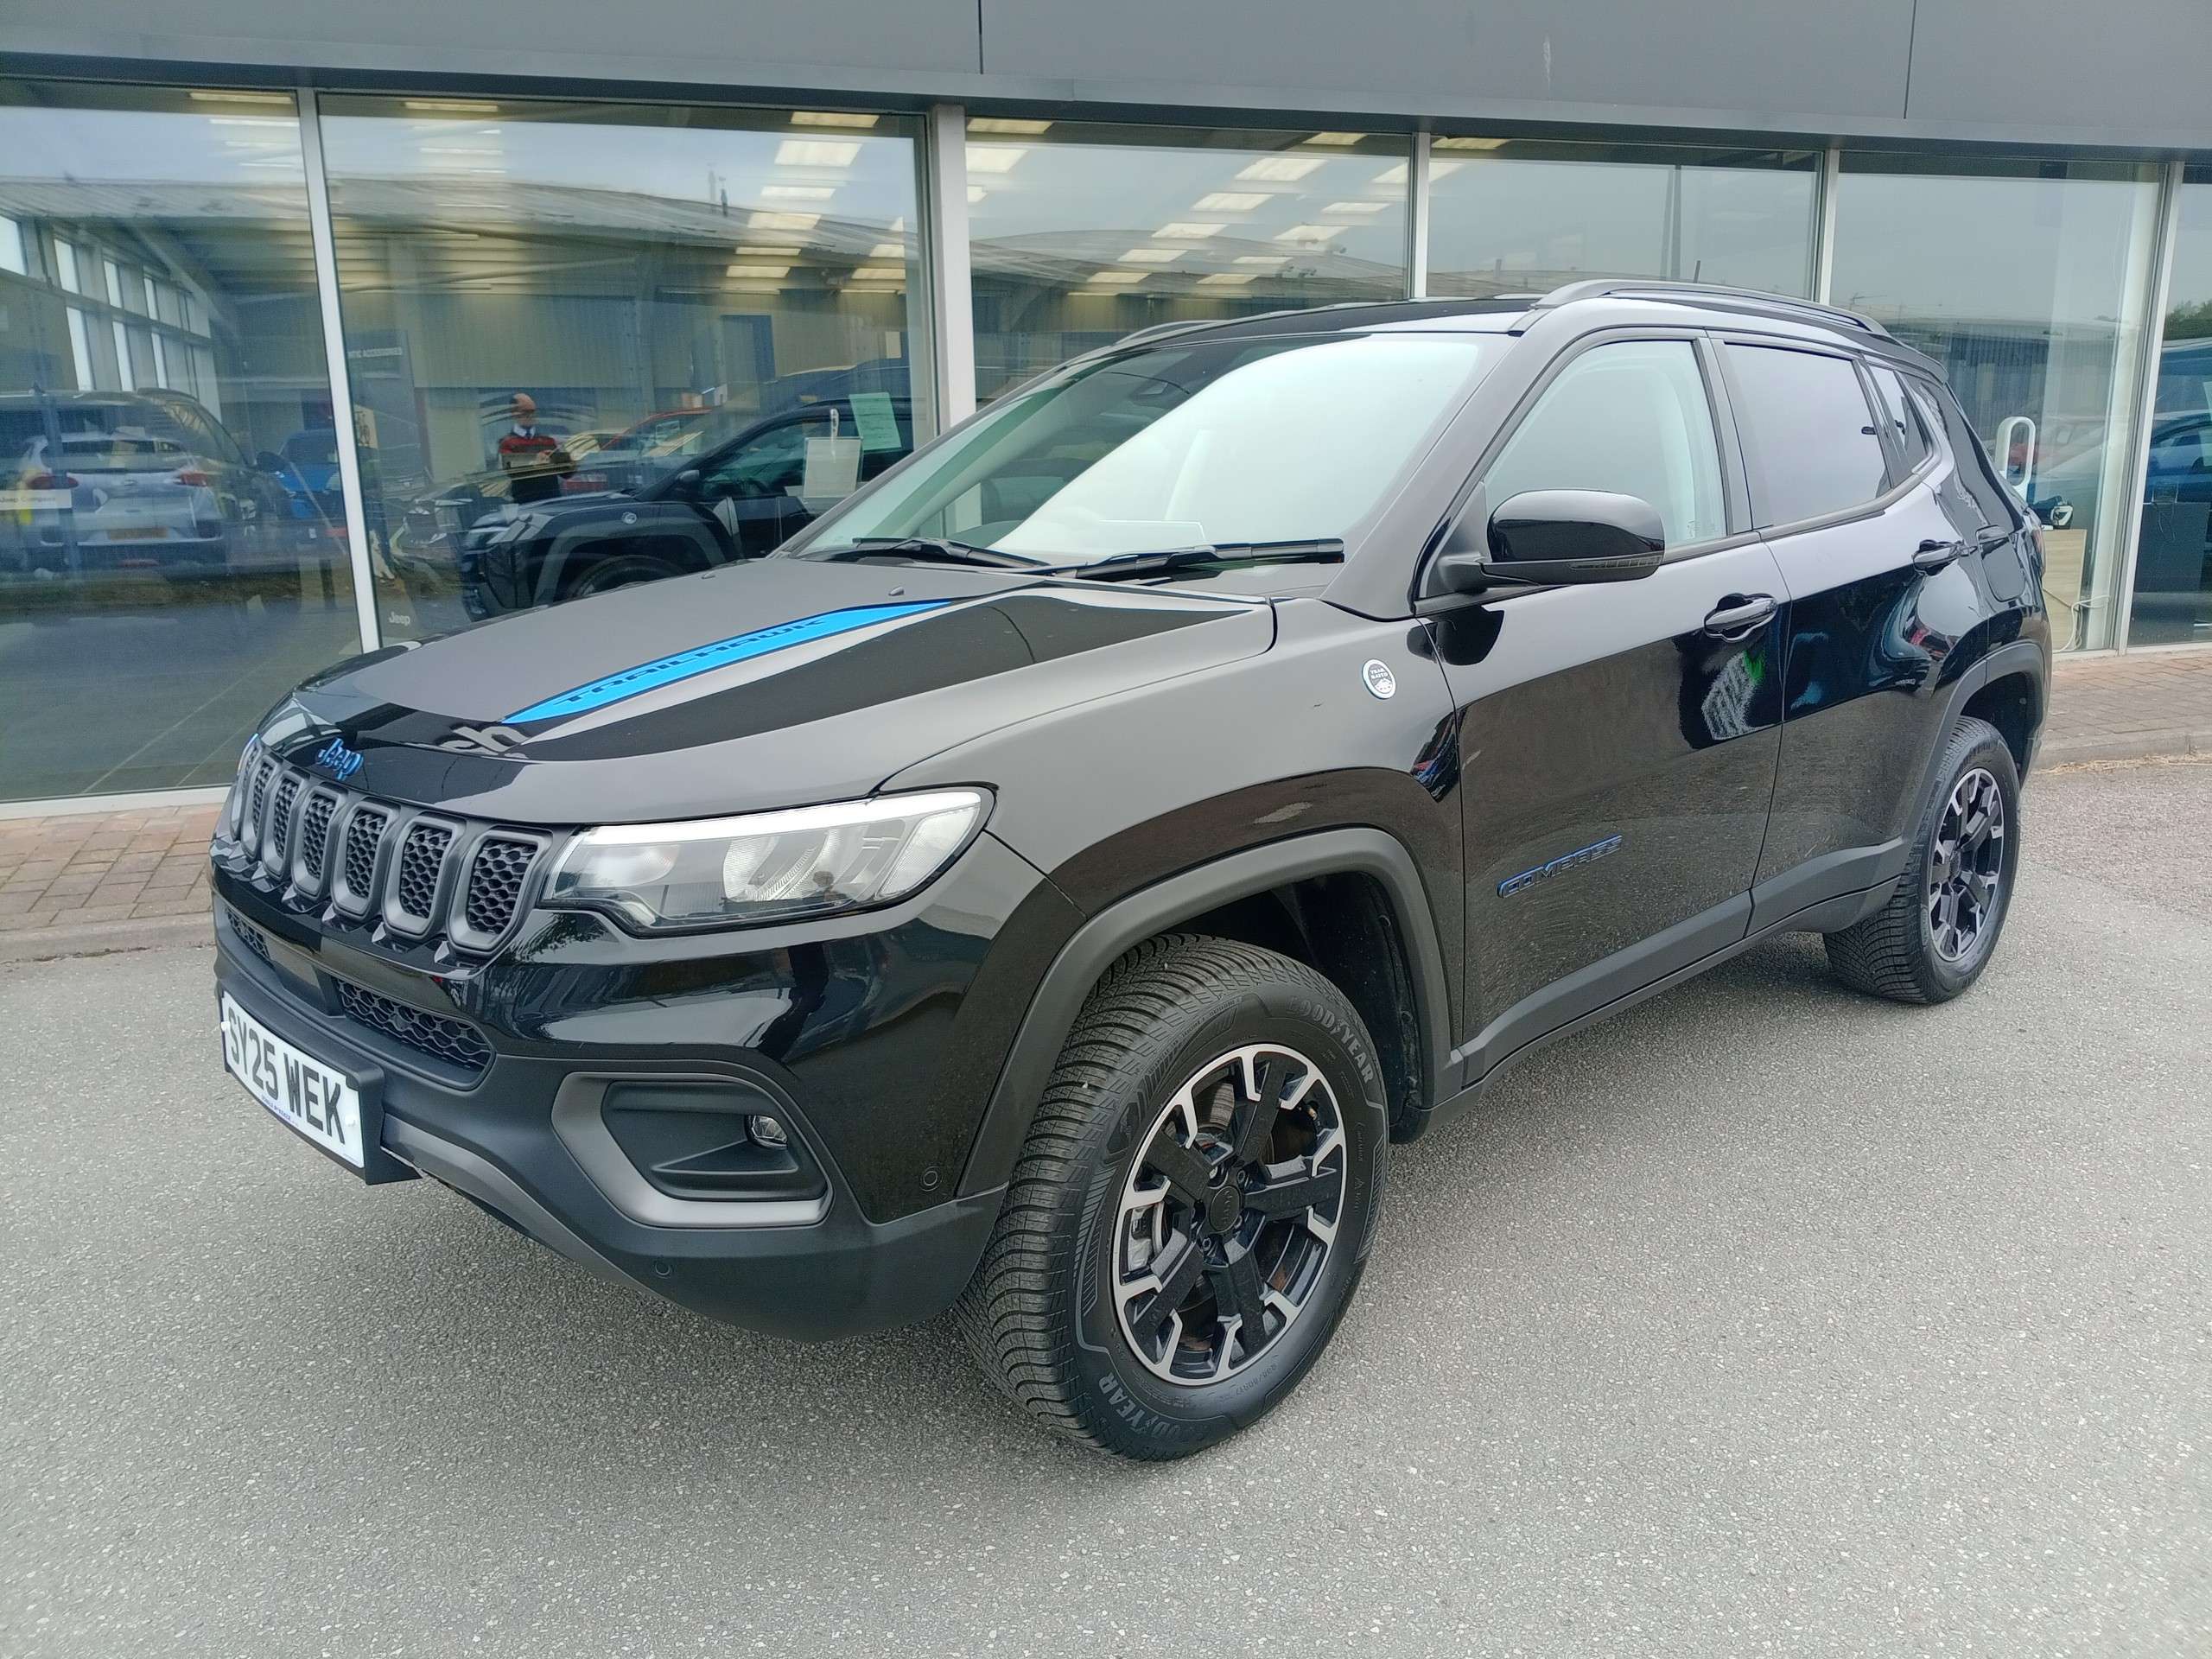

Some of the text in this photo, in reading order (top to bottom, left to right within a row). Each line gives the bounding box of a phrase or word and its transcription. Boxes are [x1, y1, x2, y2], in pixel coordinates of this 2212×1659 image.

[389, 611, 410, 626] Jeep
[553, 619, 825, 705] TRAILHAWK
[1497, 833, 1623, 899] COMPASS
[227, 1007, 346, 1145] SY25 WEK
